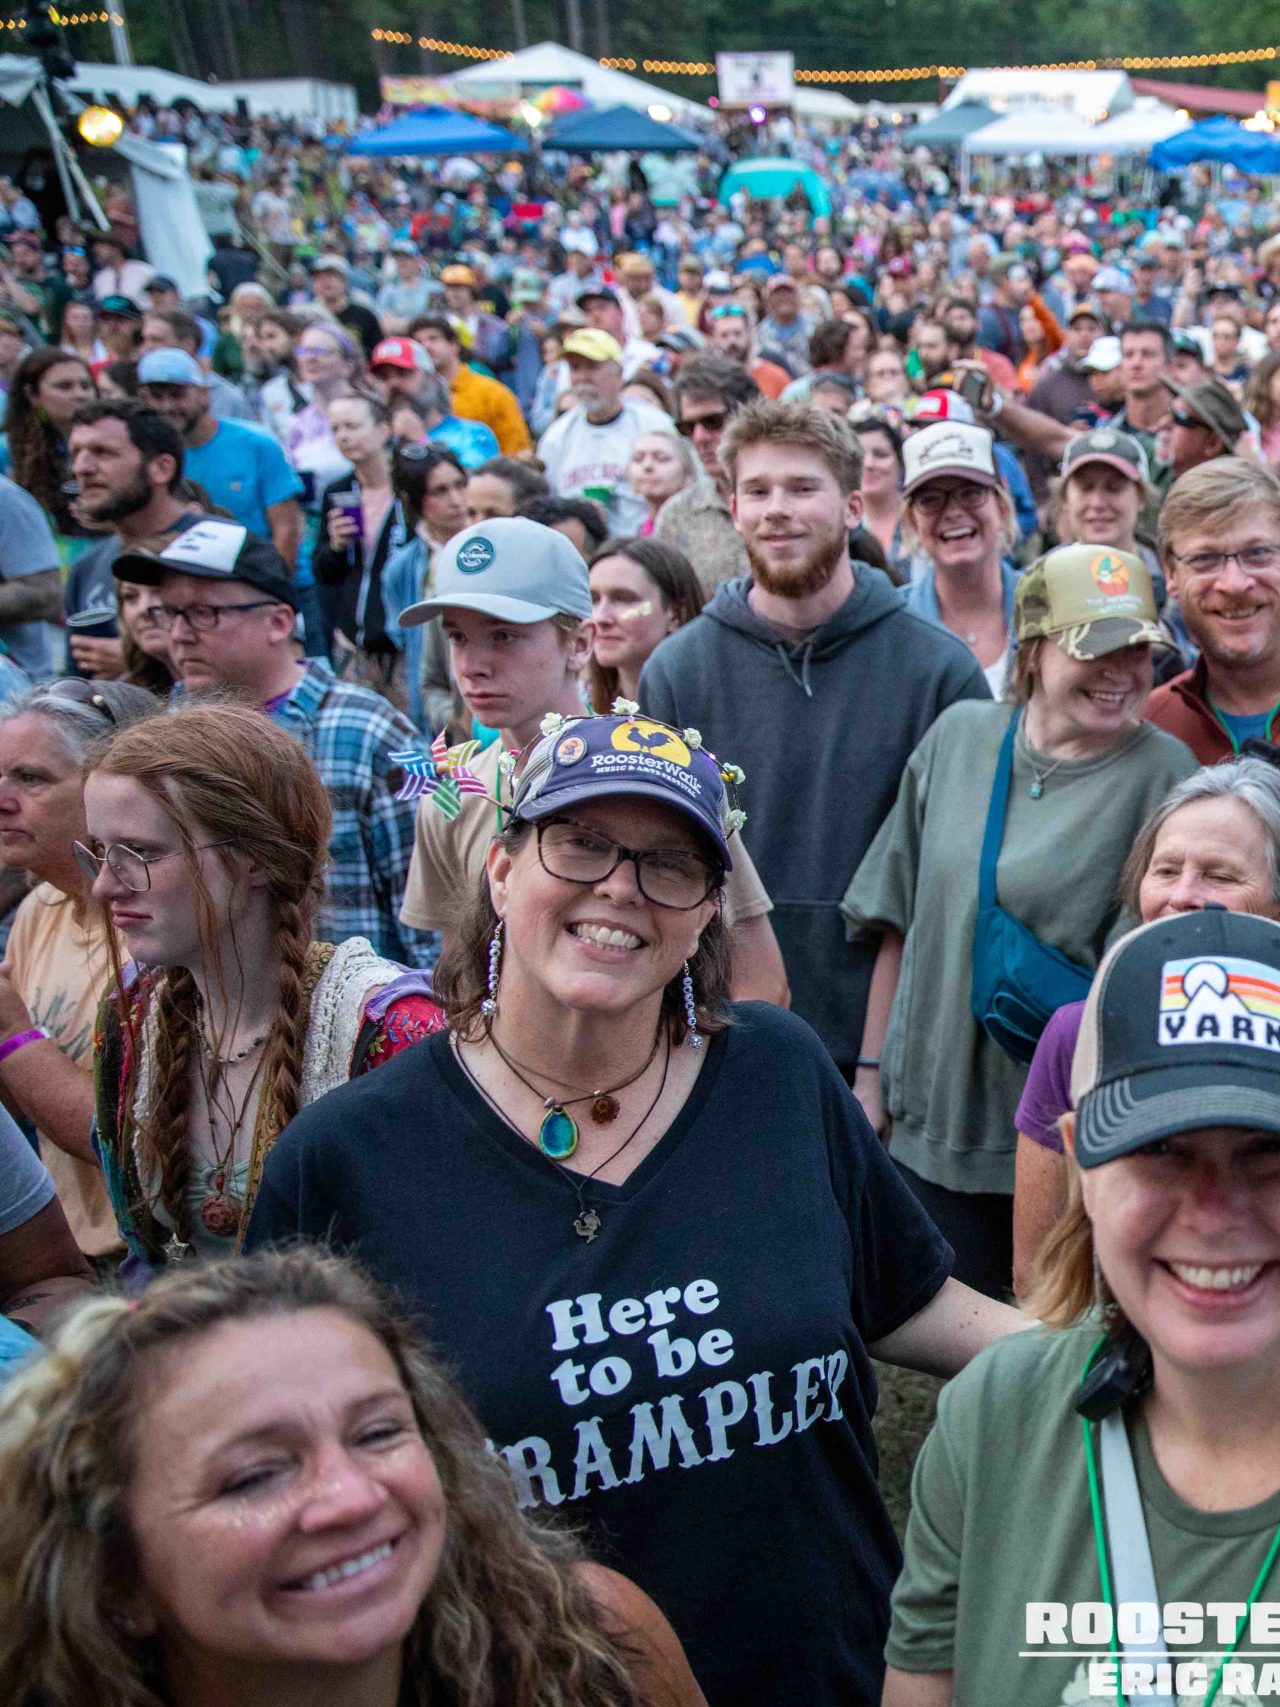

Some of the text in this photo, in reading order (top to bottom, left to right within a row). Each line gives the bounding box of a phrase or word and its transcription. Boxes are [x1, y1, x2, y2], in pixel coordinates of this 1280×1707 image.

[596, 764, 626, 774] MUSIC
[637, 765, 661, 776] ARTS
[661, 772, 697, 798] FESTIVAL
[545, 1278, 720, 1351] Here
[550, 1328, 734, 1405] to be
[485, 1349, 849, 1509] RAMPLED
